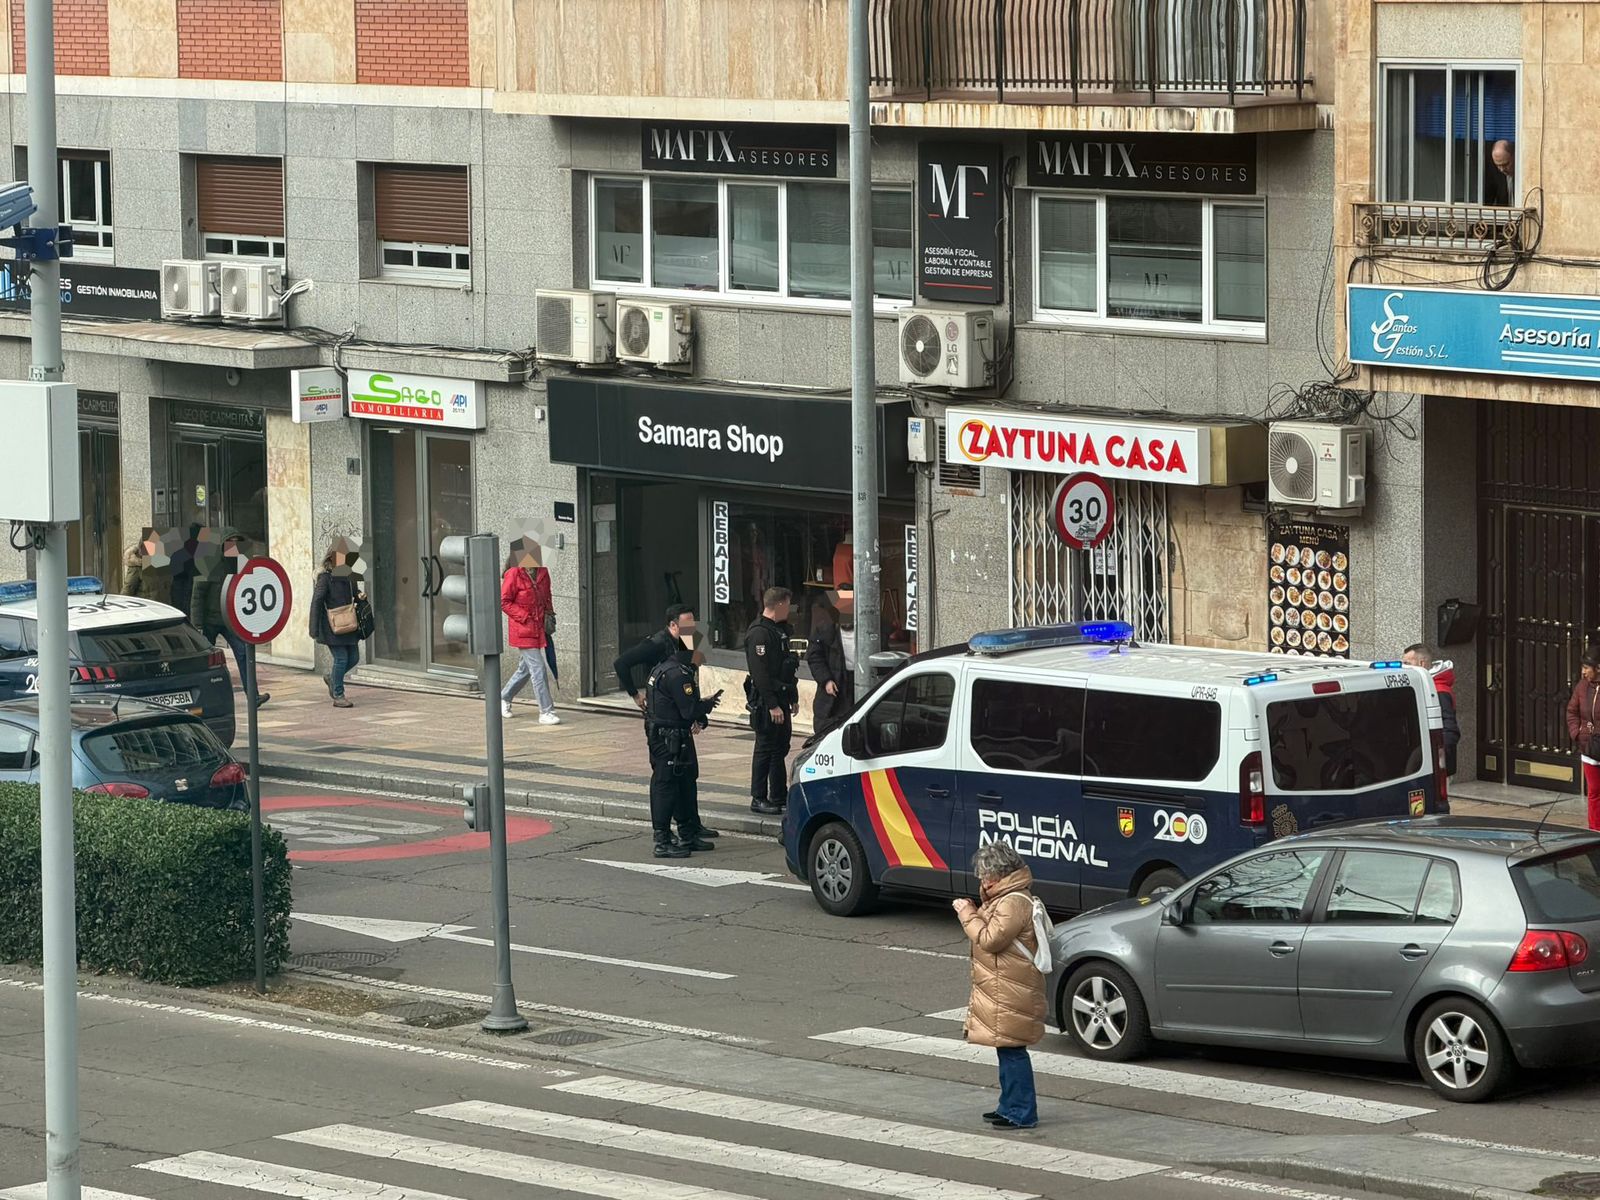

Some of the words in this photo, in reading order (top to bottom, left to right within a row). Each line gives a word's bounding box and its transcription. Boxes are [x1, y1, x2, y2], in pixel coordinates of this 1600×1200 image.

[738, 150, 829, 167] ASESORES
[1141, 166, 1247, 182] ASESORES
[925, 246, 954, 256] ASESORÍA
[925, 257, 952, 266] LABORAL
[959, 260, 992, 269] CONTABLE
[924, 266, 951, 276] GESTIÓN
[952, 268, 961, 276] DE
[962, 269, 993, 279] EMPRESAS
[77, 284, 108, 297] GESTIÓN
[108, 287, 158, 300] INMOBILIARIA
[1370, 292, 1418, 336] Santos
[946, 343, 958, 354] LG
[1372, 333, 1424, 360] Gestión
[1424, 344, 1450, 360] S.L.
[1498, 323, 1592, 350] Asesoría
[351, 373, 442, 405] SAGO
[352, 401, 444, 420] INMOBILIARIA
[638, 416, 721, 451] Samara
[726, 424, 784, 463] Shop
[966, 421, 1100, 467] ZAYTUNA
[1105, 435, 1188, 474] CASA
[1069, 496, 1101, 524] 30
[1280, 525, 1316, 536] ZAYTUNA
[1316, 528, 1339, 541] CASA
[715, 503, 728, 601] REBAJAS
[241, 583, 277, 616] 30
[978, 808, 1079, 841] POLICÍA
[979, 830, 1109, 868] NACIONAL
